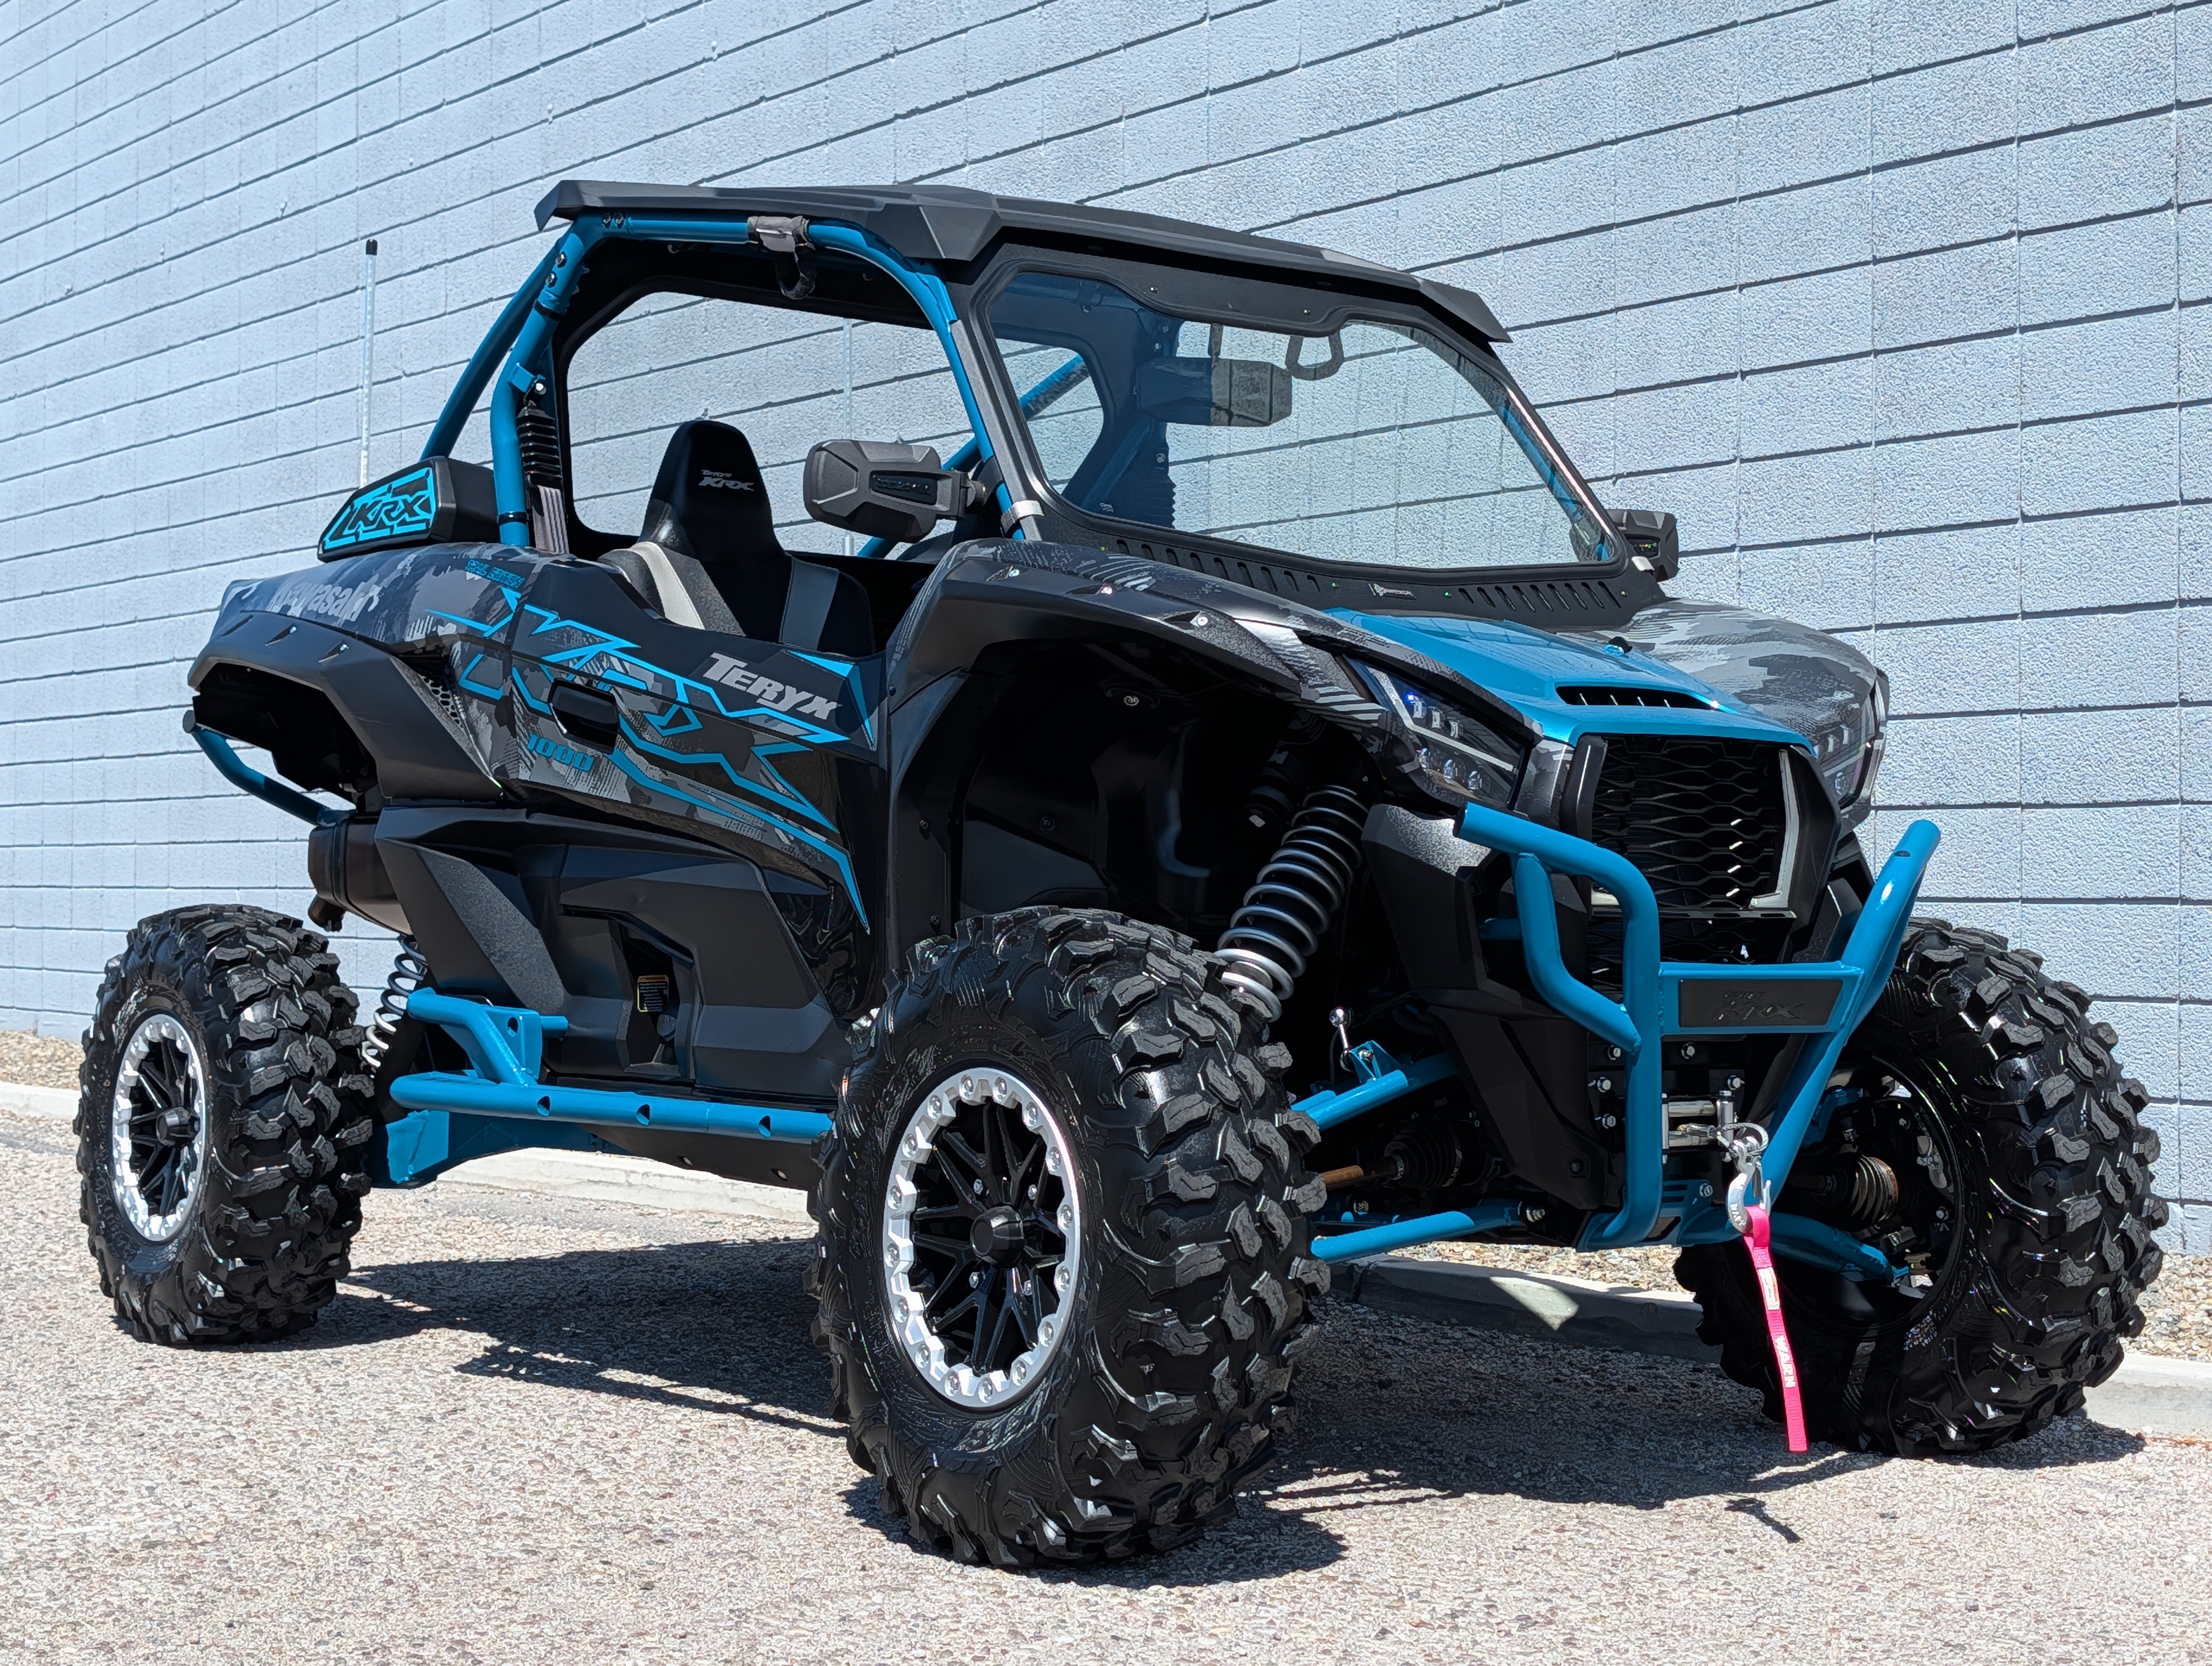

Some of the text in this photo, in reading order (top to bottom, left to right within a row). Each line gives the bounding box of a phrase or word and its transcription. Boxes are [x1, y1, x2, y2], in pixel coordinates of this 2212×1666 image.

[698, 477, 755, 491] KRX
[347, 494, 427, 530] KRX
[526, 733, 594, 773] 1000
[1774, 1335, 1796, 1388] WARN
